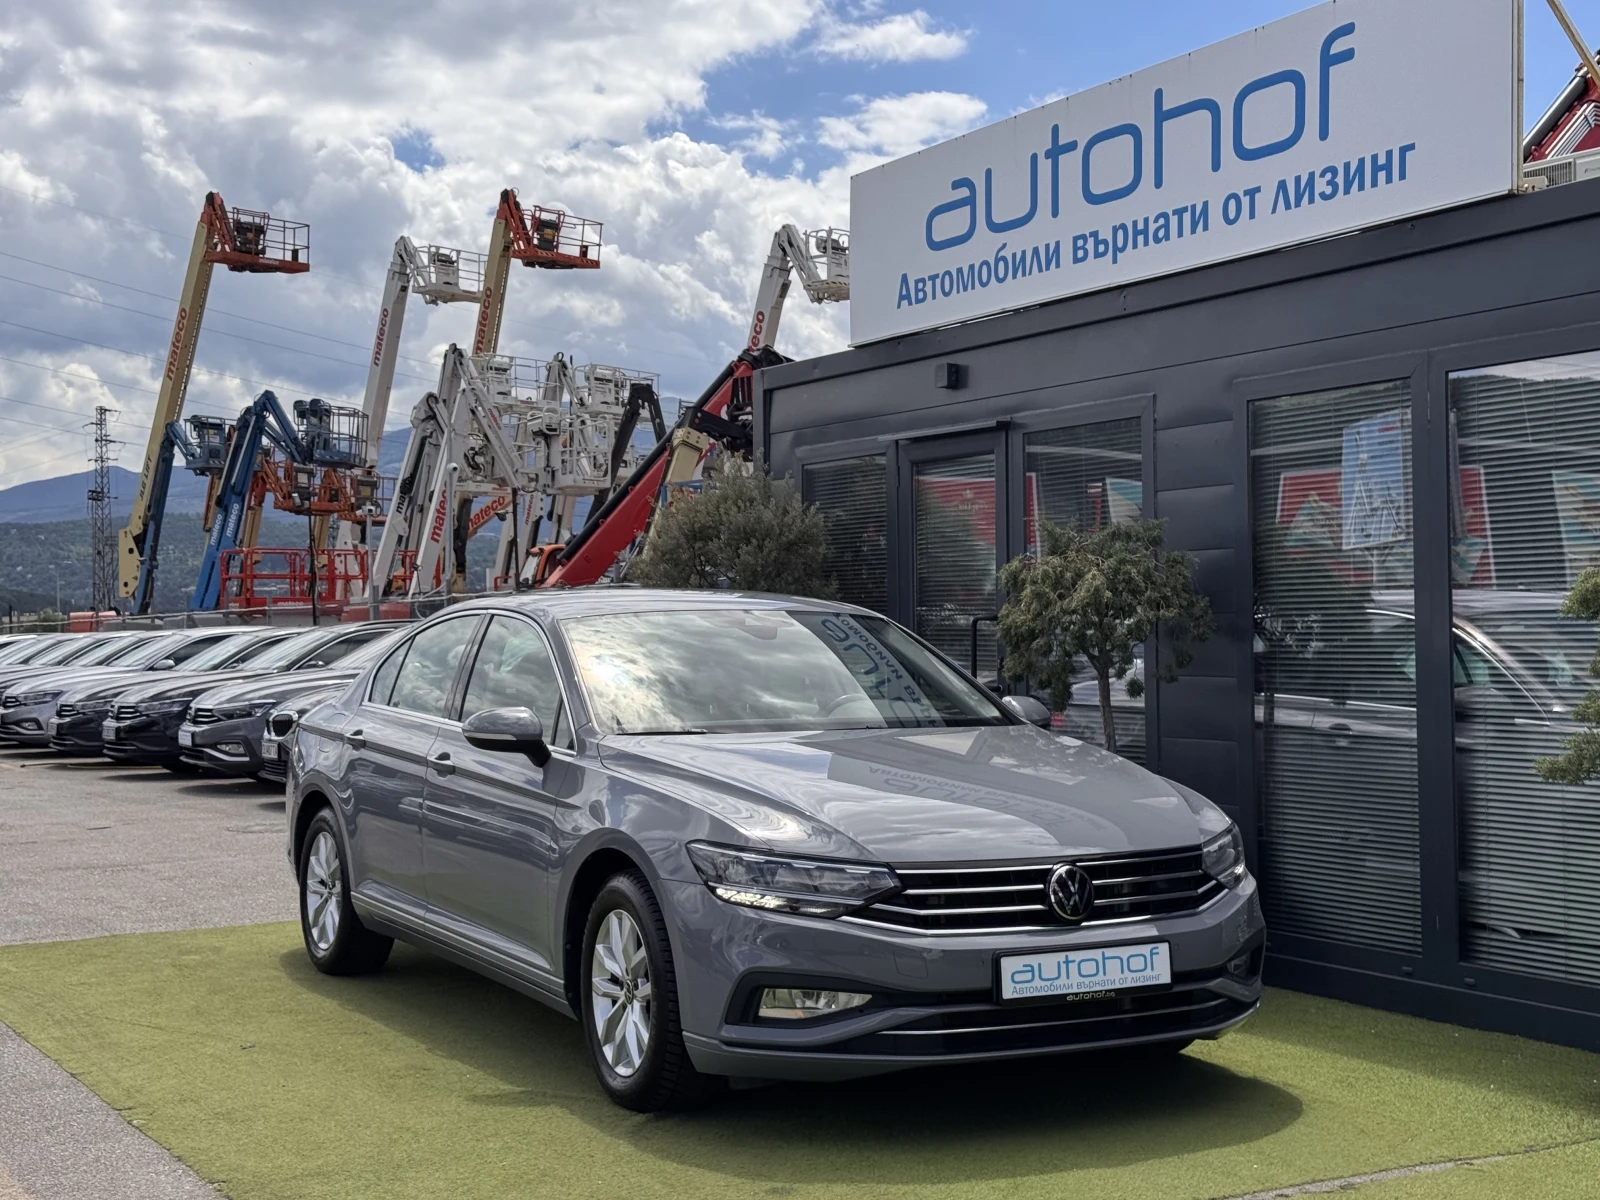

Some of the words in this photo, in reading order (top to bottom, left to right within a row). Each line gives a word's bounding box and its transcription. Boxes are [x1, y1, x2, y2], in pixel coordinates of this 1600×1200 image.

[925, 21, 1356, 252] autohof
[896, 239, 1062, 310] Автомобили
[1071, 200, 1210, 265] върнати
[1222, 185, 1262, 227] от
[1271, 142, 1416, 215] лизинг
[166, 307, 188, 382] mateco
[373, 307, 389, 368] mateco
[748, 310, 765, 353] teco
[210, 513, 223, 546] mateco
[226, 503, 240, 538] mateco
[430, 481, 447, 544] matec
[1011, 946, 1160, 985] autohof
[1011, 981, 1073, 996] Автомобили
[1076, 977, 1116, 990] върнати
[1118, 976, 1129, 985] от
[1130, 973, 1162, 984] лизинг
